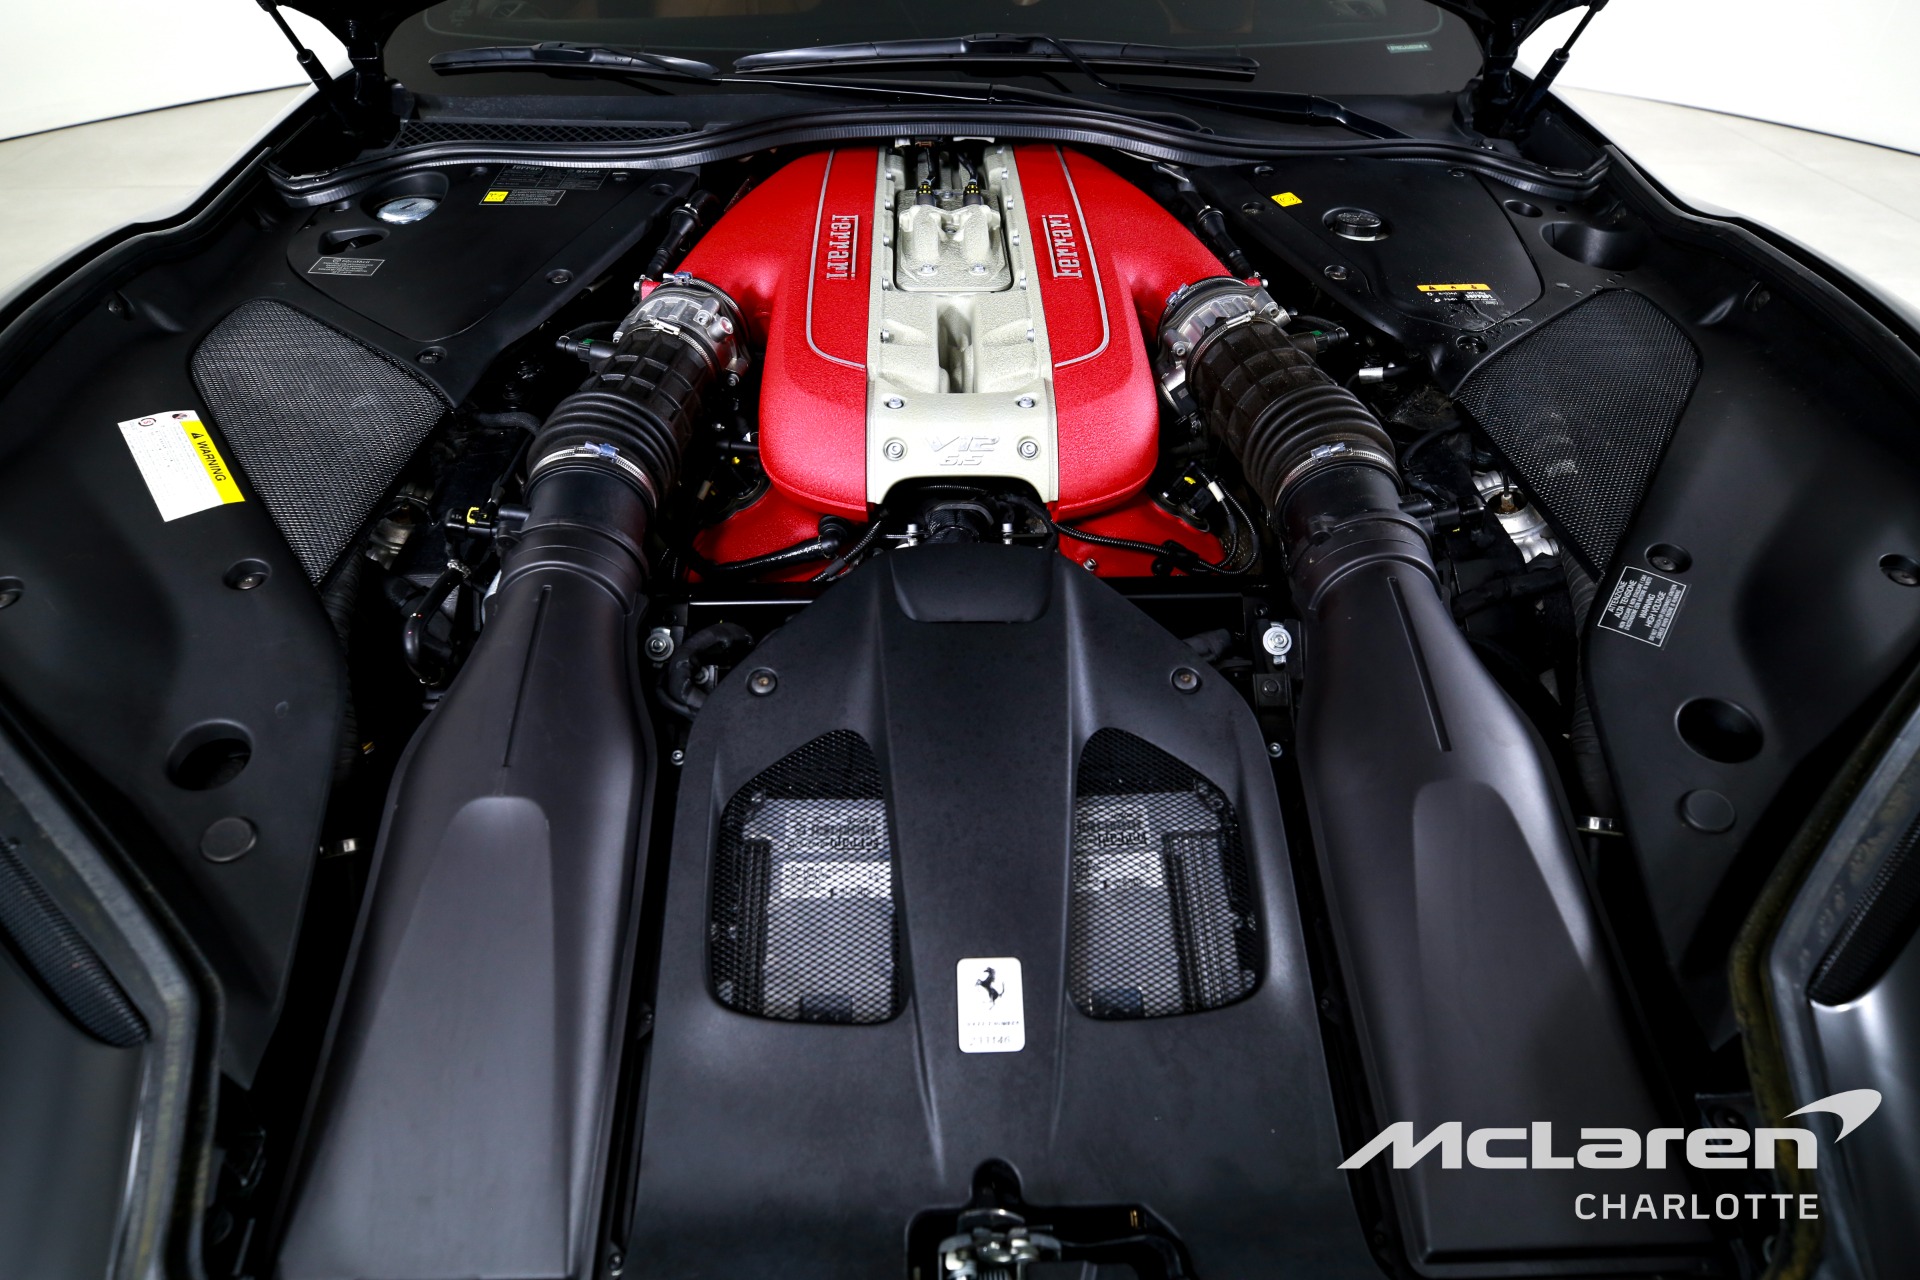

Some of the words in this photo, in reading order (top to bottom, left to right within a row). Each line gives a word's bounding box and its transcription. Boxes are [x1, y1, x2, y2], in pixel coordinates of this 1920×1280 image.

[826, 214, 859, 280] Ferrari
[1041, 213, 1082, 279] Ferrari
[197, 440, 227, 482] WARNING
[925, 435, 1000, 452] V12
[1608, 581, 1627, 612] ATTENZIONE
[1614, 605, 1625, 618] ALTA
[1620, 580, 1637, 605] TENSIONE
[1638, 593, 1656, 619] WARNING
[1644, 612, 1657, 628] HIGH
[1651, 591, 1667, 613] VOLTAGE
